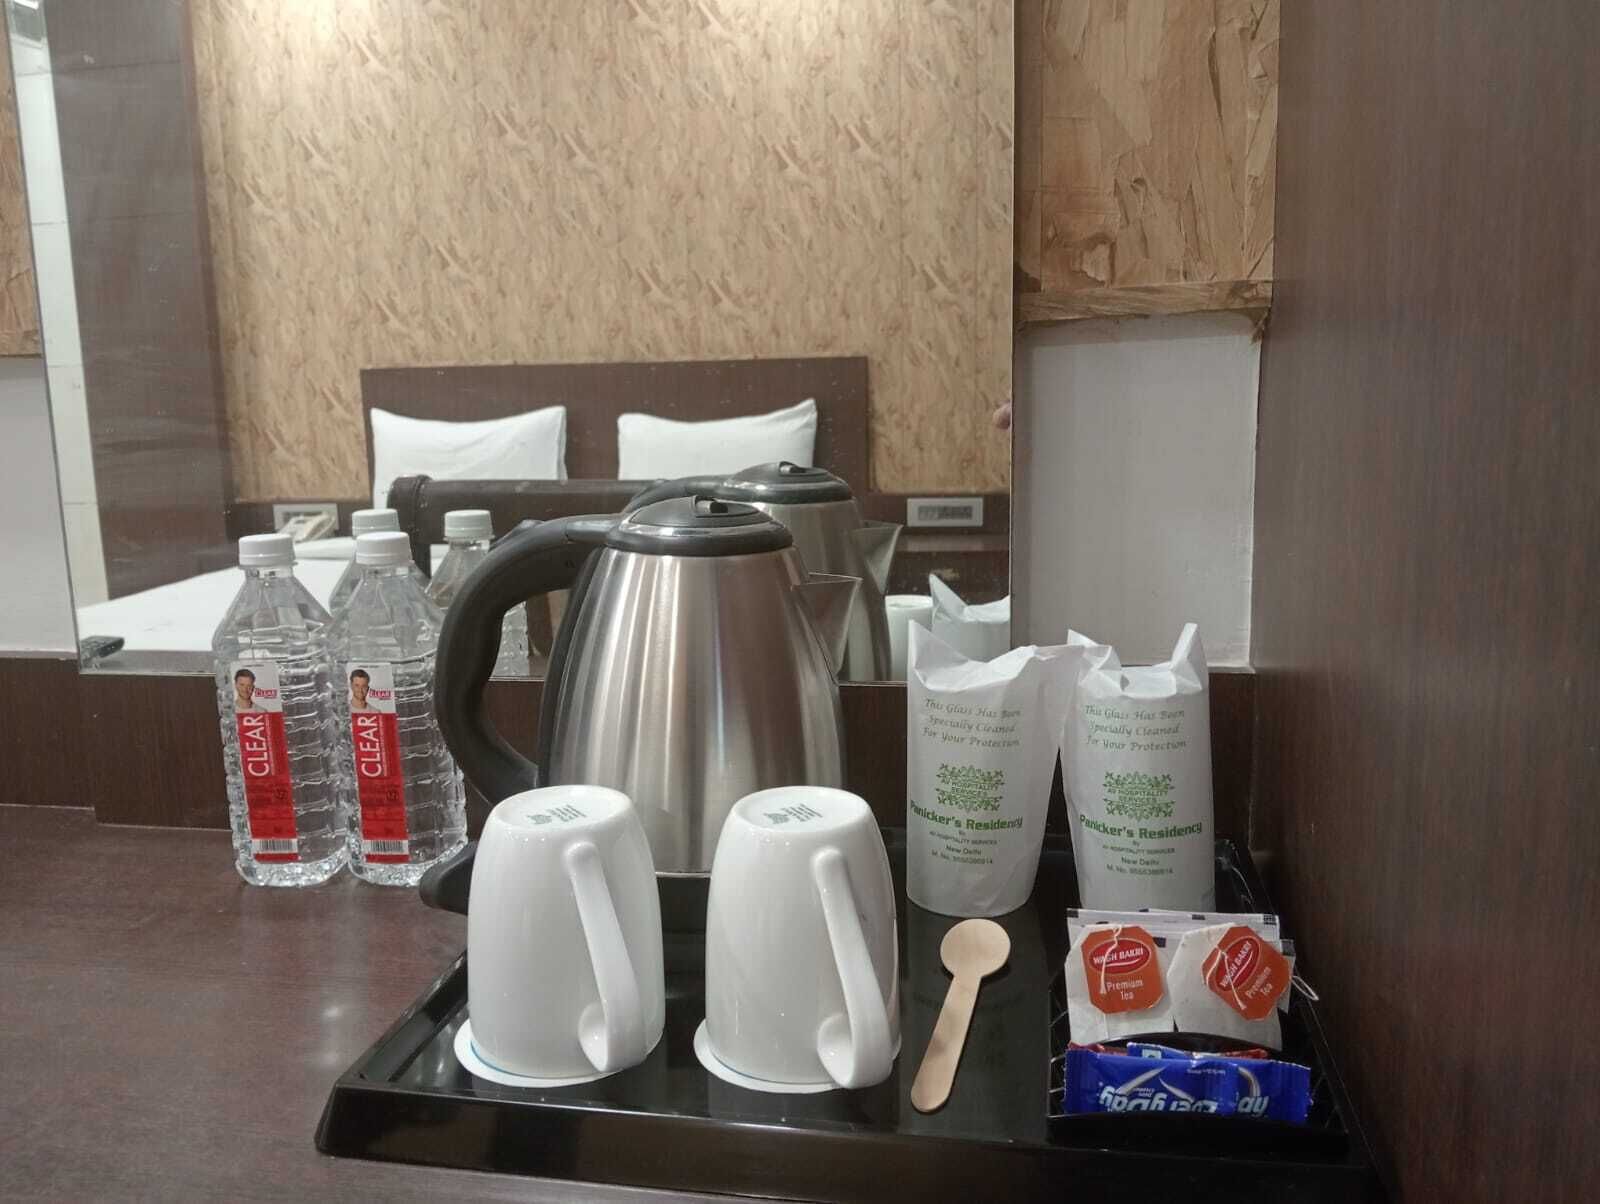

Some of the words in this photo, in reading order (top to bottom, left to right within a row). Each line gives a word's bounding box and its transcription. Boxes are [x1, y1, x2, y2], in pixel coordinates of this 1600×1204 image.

[946, 703, 972, 716] Glass
[976, 707, 997, 718] Has
[1104, 708, 1129, 720] Glass
[1135, 710, 1158, 720] Has
[928, 714, 973, 732] Specially
[976, 722, 1016, 733] Cleaned
[1089, 720, 1133, 737] Specially
[1135, 722, 1180, 736] Cleaned
[243, 714, 270, 777] CLEAR
[357, 715, 383, 777] CLEAR
[969, 736, 1020, 748] Protection
[1130, 740, 1186, 751] Protection
[966, 817, 1023, 831] Residency
[1080, 814, 1134, 838] Panicker's
[1139, 822, 1202, 839] Residency
[1121, 856, 1137, 864] New
[1106, 979, 1144, 991] Premium
[1245, 966, 1272, 999] Premium
[1120, 989, 1135, 1000] Tea
